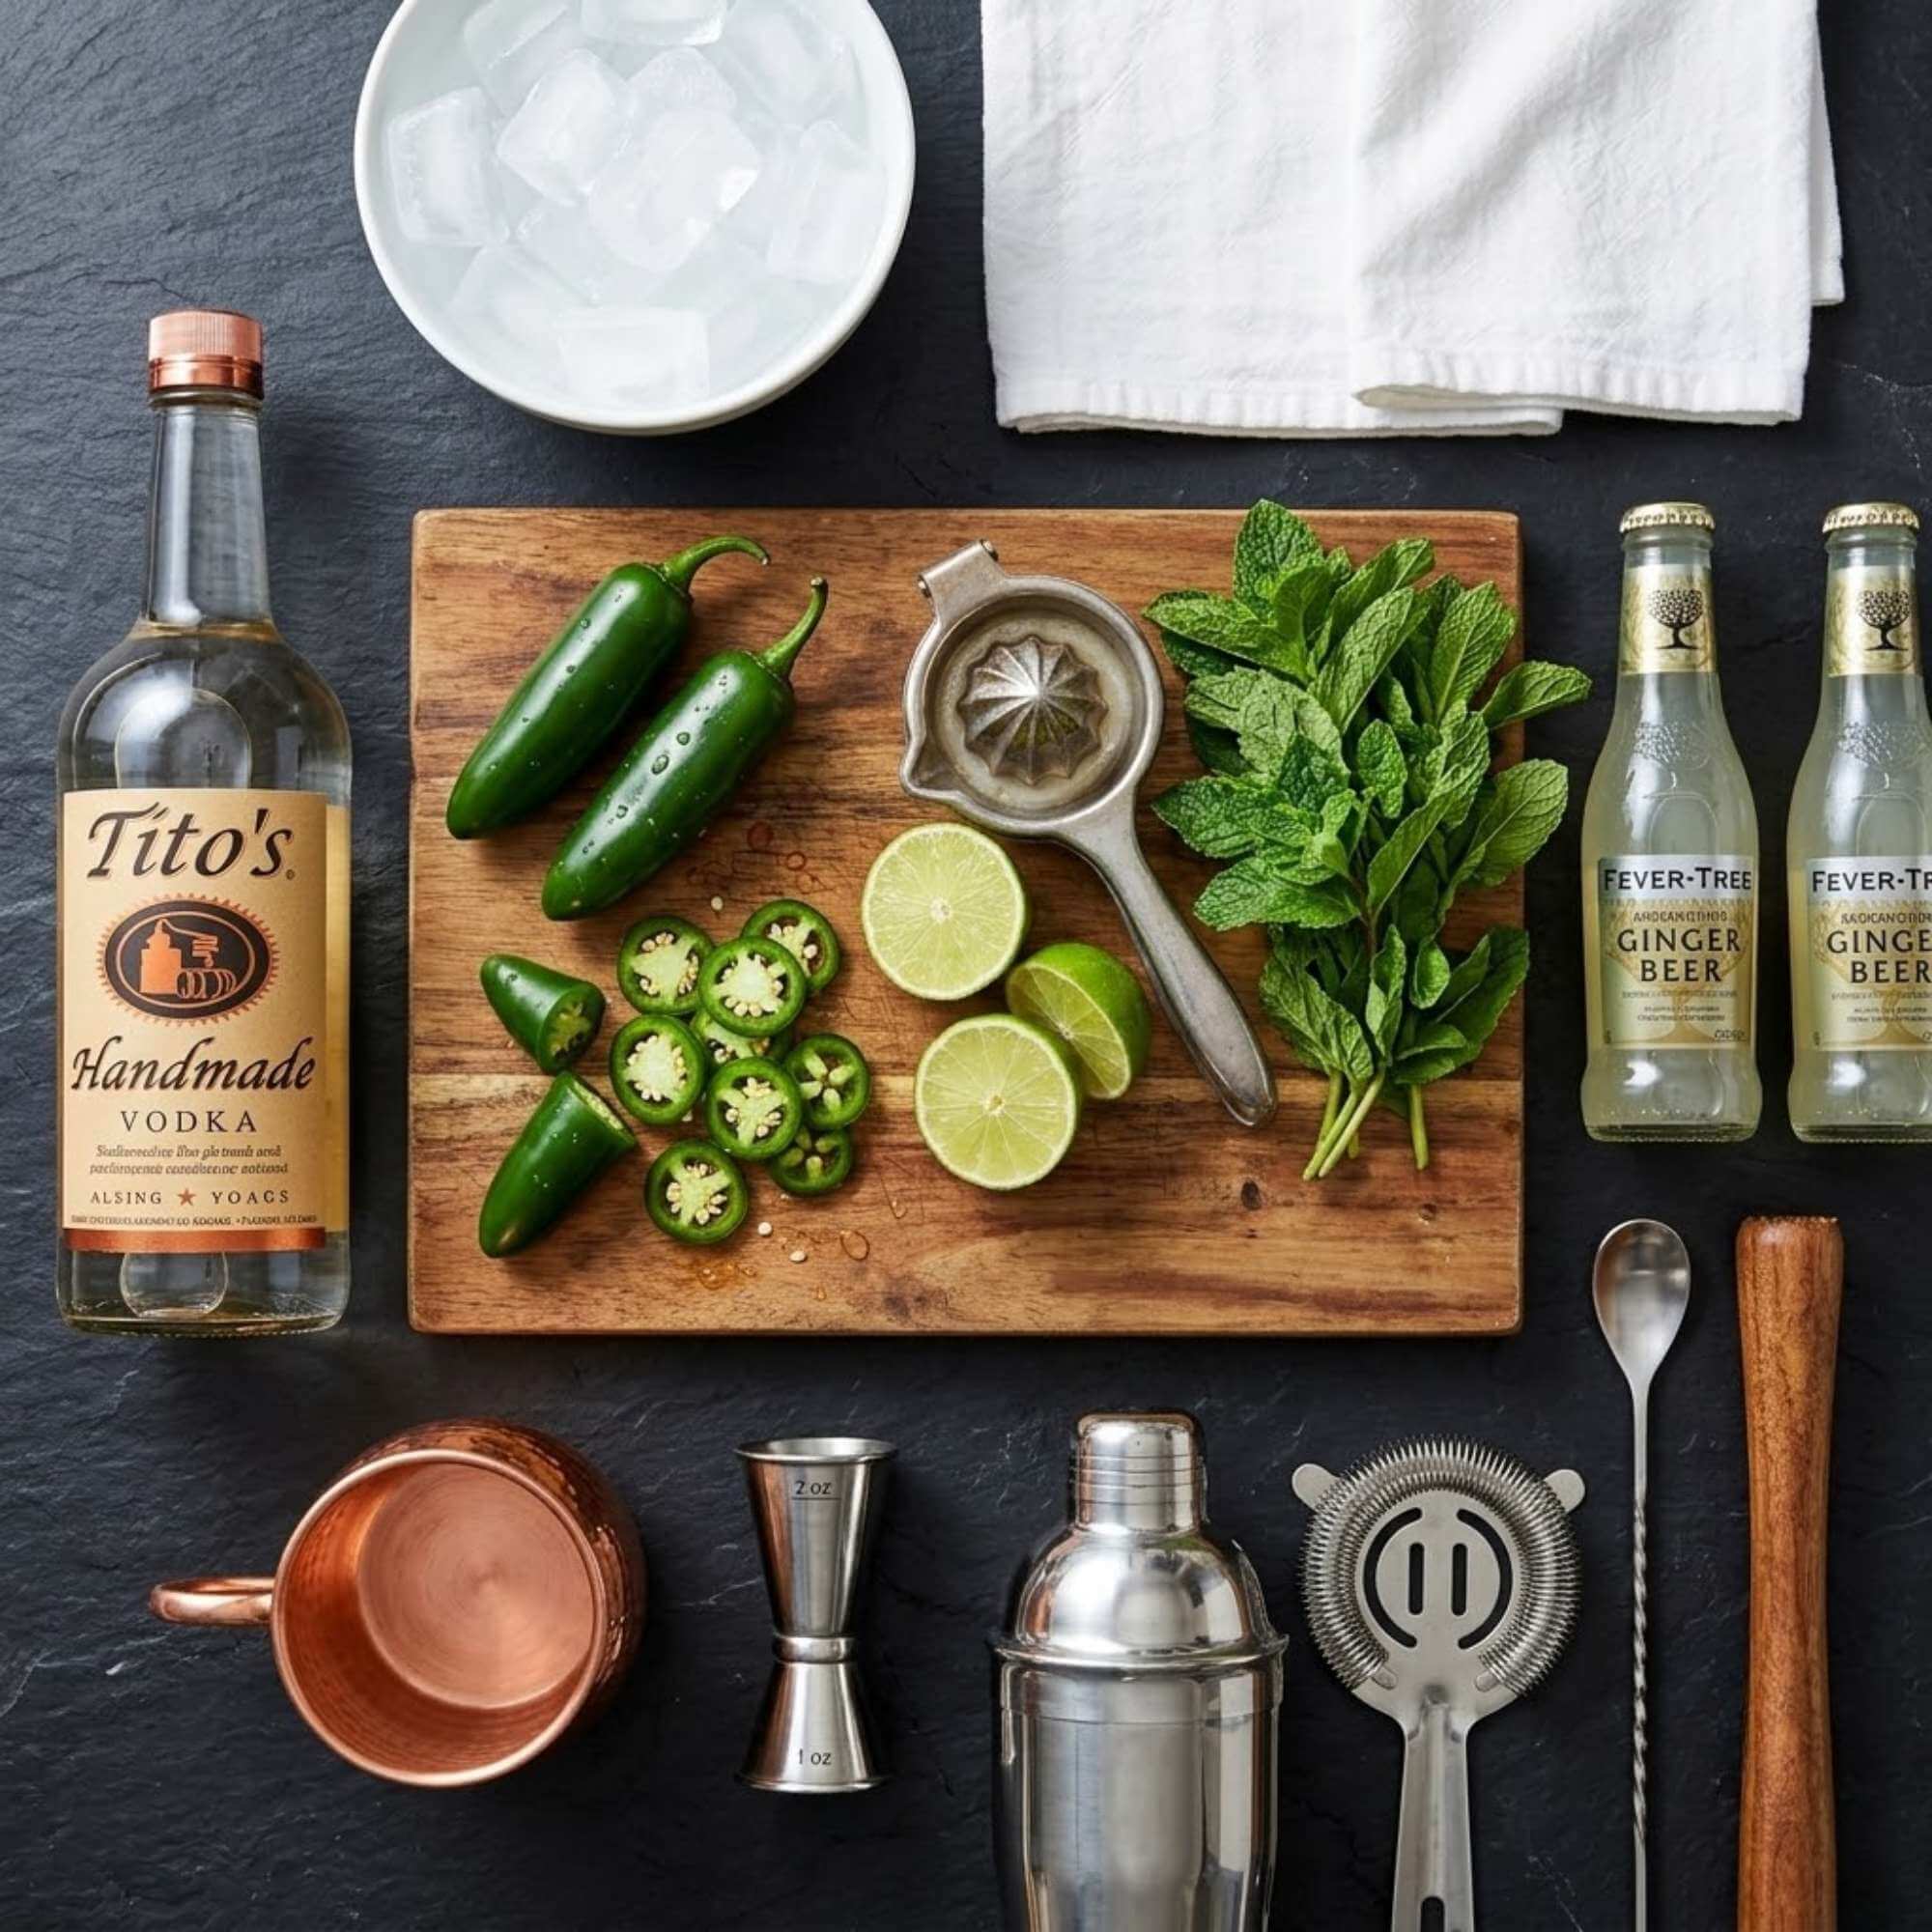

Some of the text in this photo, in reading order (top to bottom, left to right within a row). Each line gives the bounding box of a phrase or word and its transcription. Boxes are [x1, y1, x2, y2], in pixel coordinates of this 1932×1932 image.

[1604, 867, 1752, 890] FEVER-TREE
[1617, 928, 1741, 952] GINGER
[1641, 959, 1722, 981] BEER
[1851, 960, 1932, 983] BEER
[71, 1035, 317, 1091] Handmade
[121, 1111, 257, 1132] VODKA
[91, 1191, 162, 1205] ALSING
[795, 1480, 832, 1494] 2 oz
[798, 1748, 832, 1765] 1 oz
